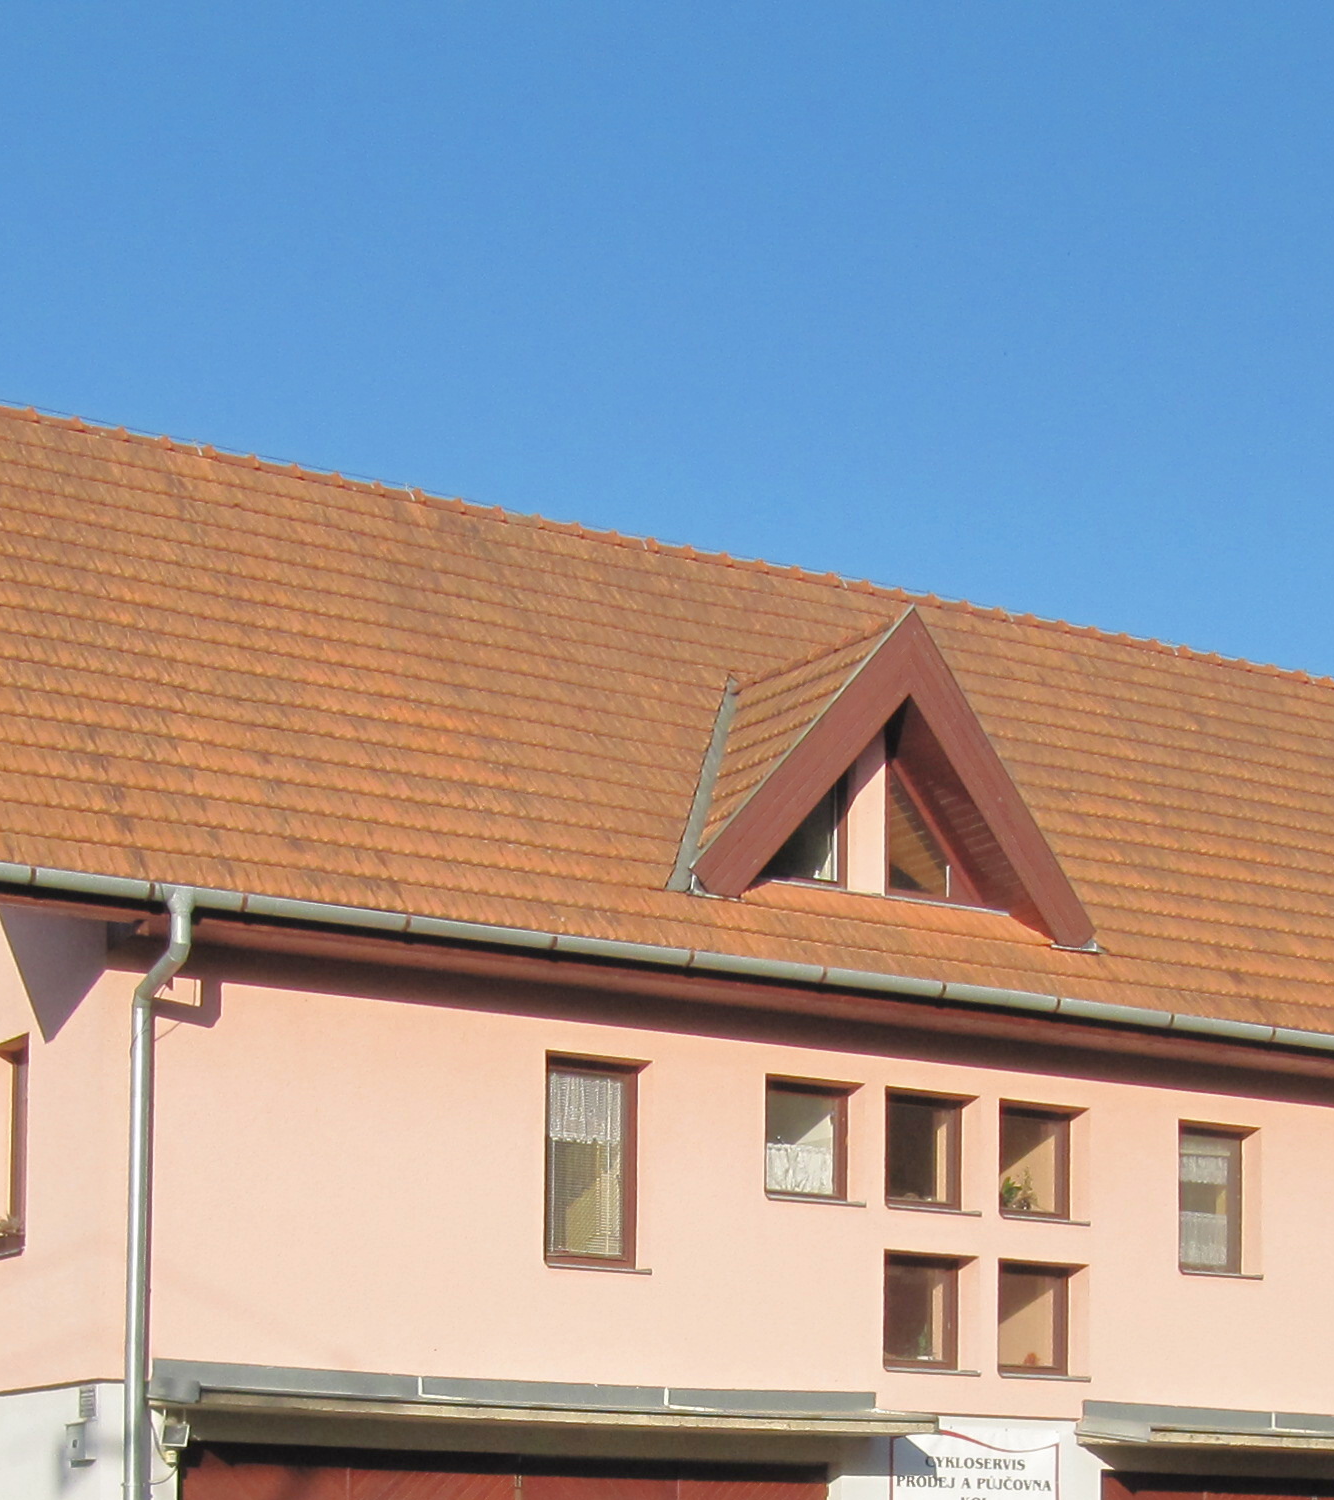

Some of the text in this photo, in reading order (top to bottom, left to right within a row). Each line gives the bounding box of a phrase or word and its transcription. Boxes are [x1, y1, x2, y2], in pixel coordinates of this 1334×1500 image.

[924, 1456, 1026, 1471] CYKLOSERVIS
[896, 1475, 955, 1489] PRODEJ
[960, 1477, 972, 1489] A
